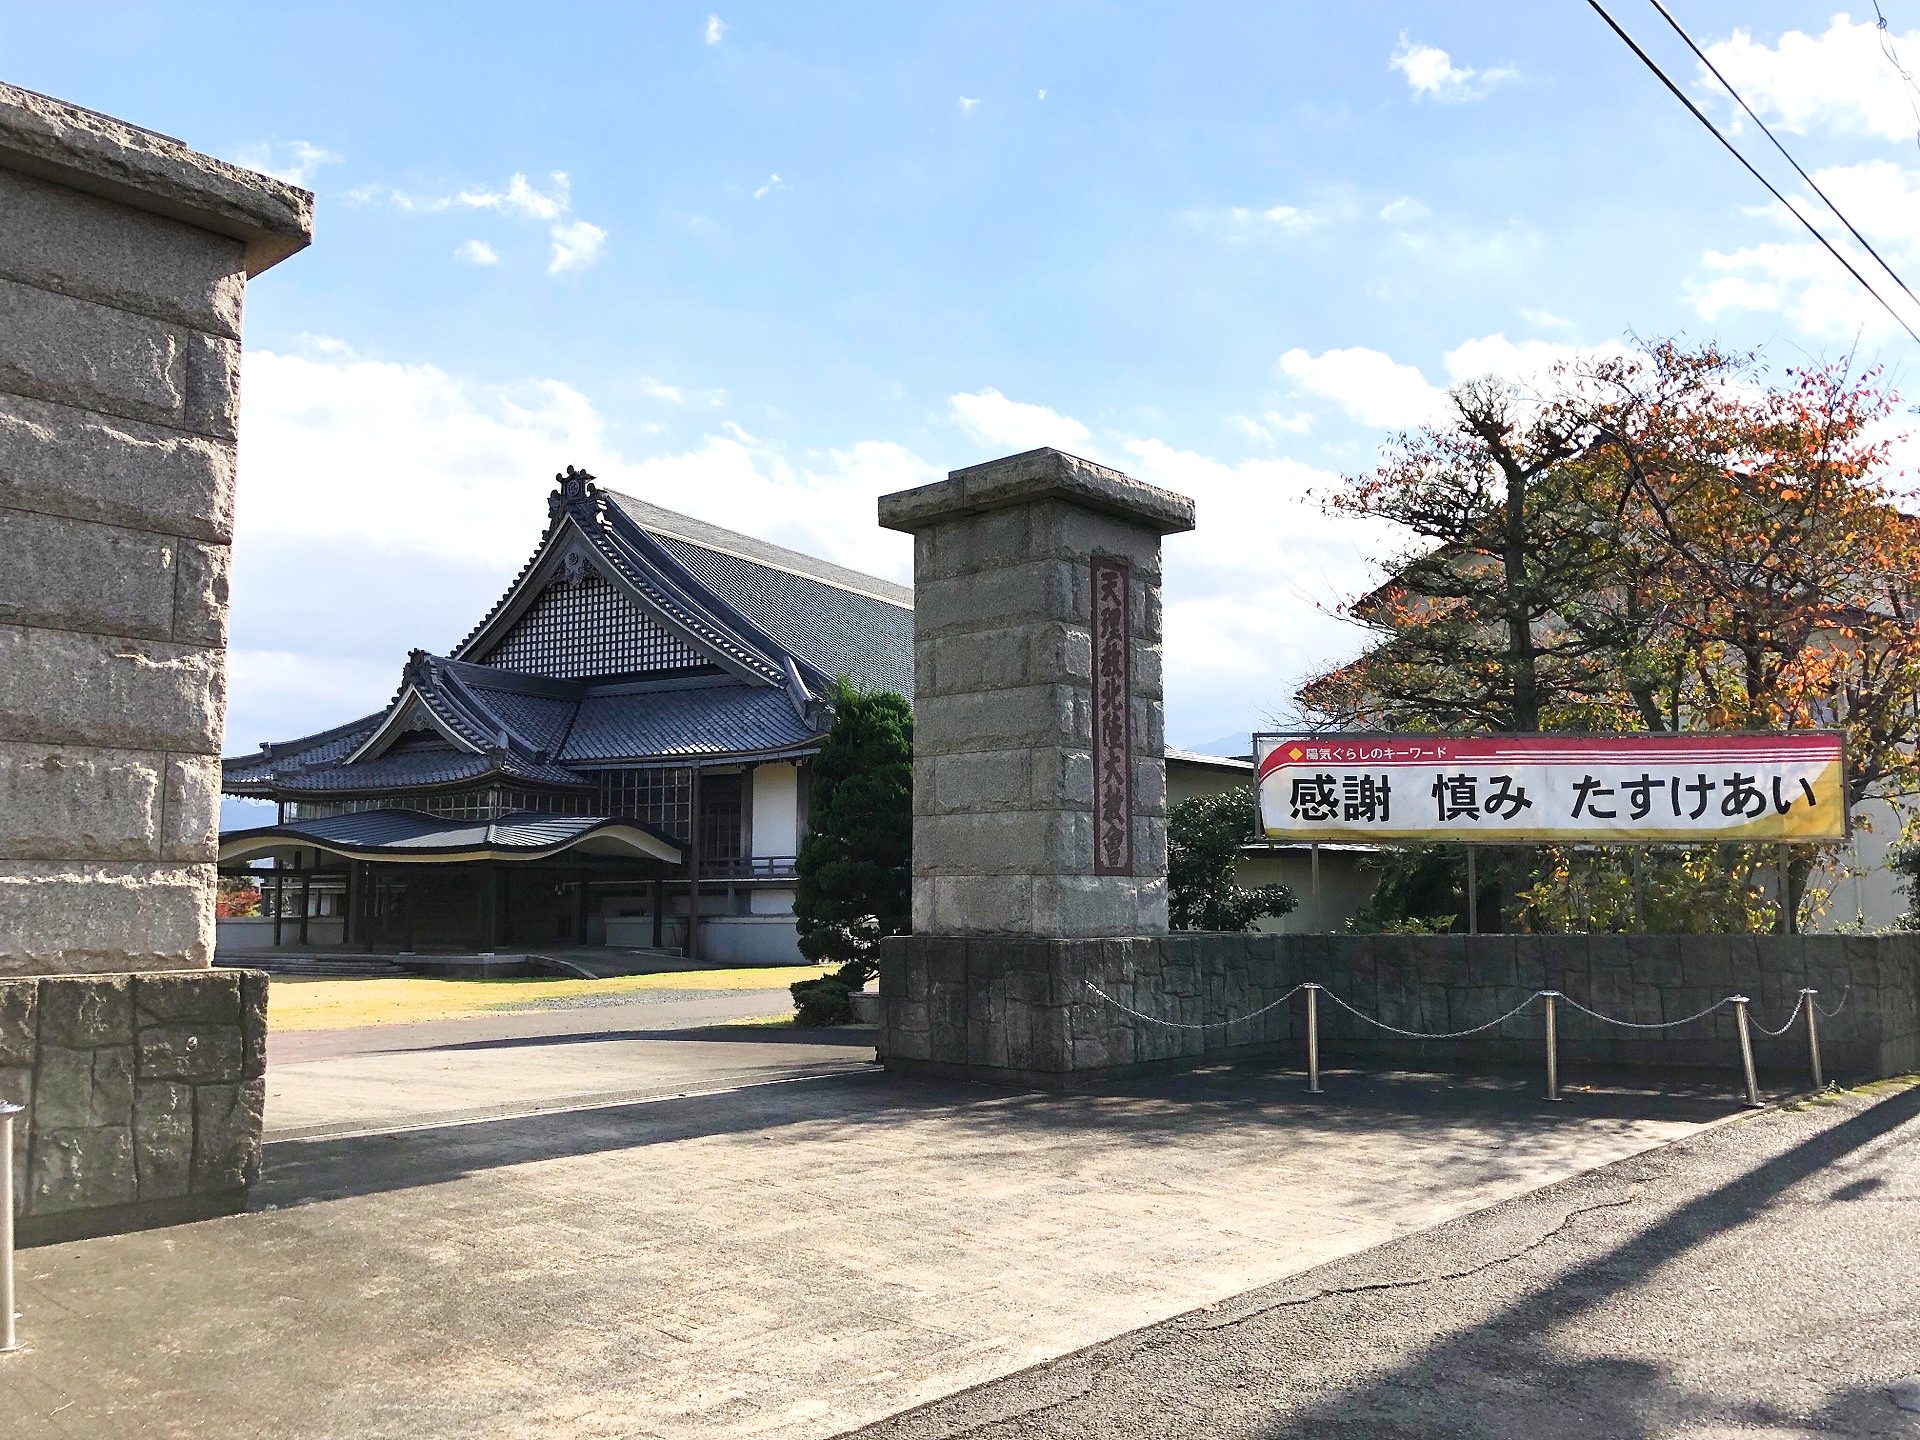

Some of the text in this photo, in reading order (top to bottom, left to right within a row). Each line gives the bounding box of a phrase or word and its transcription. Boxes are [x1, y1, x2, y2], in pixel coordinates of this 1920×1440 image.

[1305, 746, 1448, 761] 陽気ぐらしのキーワード
[1289, 771, 1817, 822] 感謝 慎み たすけあい
